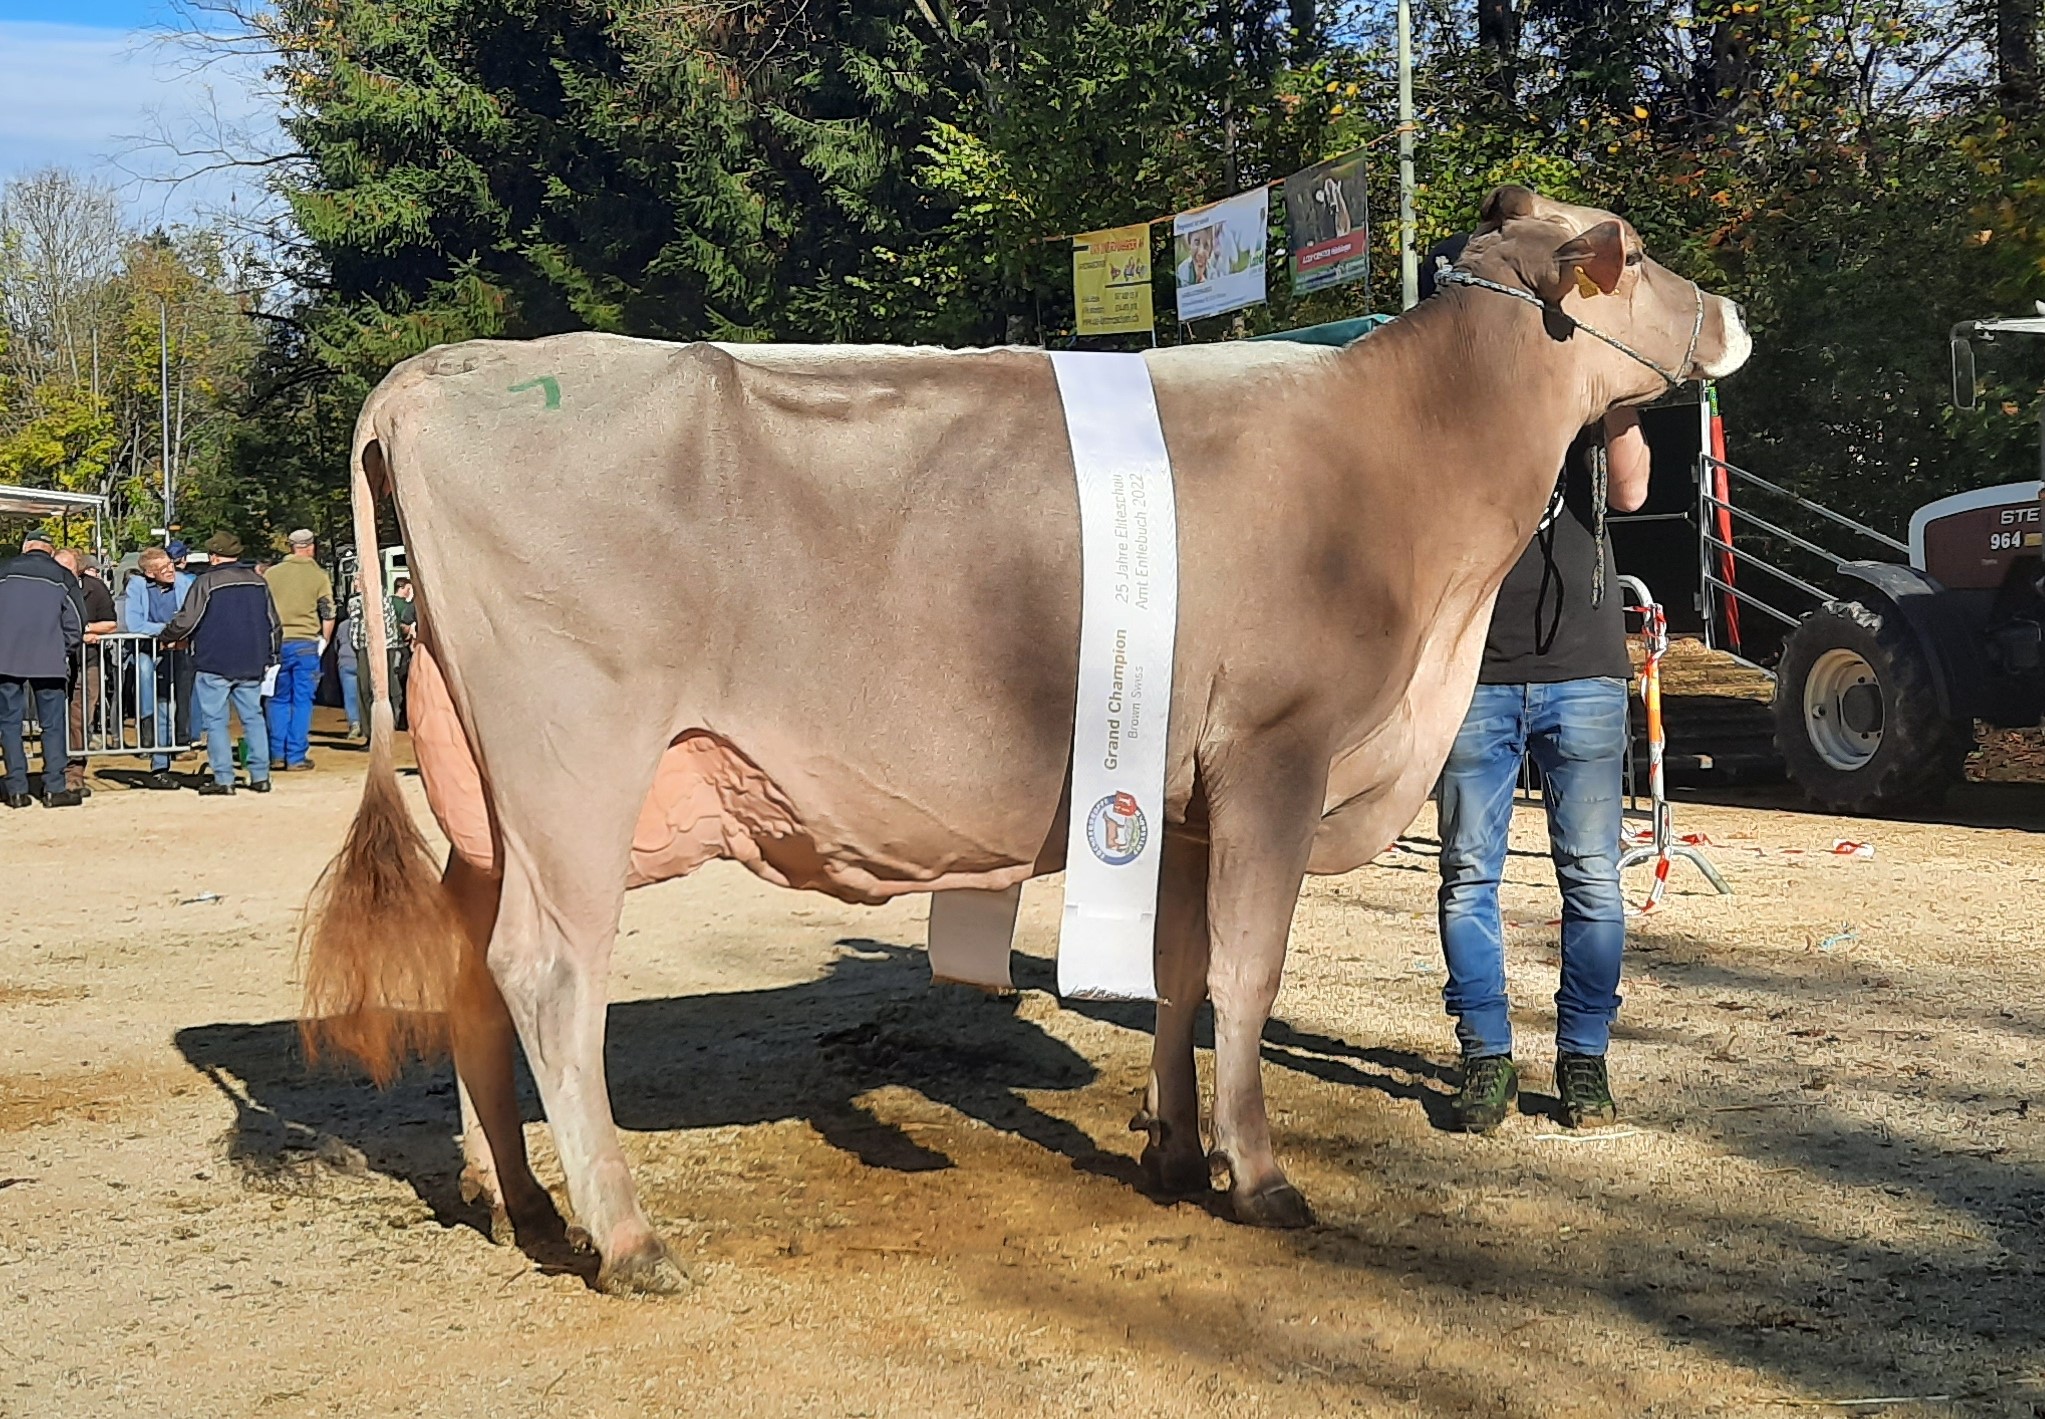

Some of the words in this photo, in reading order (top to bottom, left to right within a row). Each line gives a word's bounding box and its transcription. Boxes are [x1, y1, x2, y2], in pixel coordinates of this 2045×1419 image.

[1111, 474, 1127, 539] Eliteschau
[1129, 473, 1145, 508] 2022
[1134, 511, 1148, 577] Entlebuch
[1990, 530, 2021, 550] 964
[1114, 542, 1128, 580] Jahre
[1115, 584, 1129, 604] 25
[1135, 580, 1148, 610] Amt
[1108, 629, 1127, 713] Champion
[1131, 665, 1144, 698] Swiss
[1128, 702, 1141, 739] Brown
[1104, 719, 1120, 771] Grand
